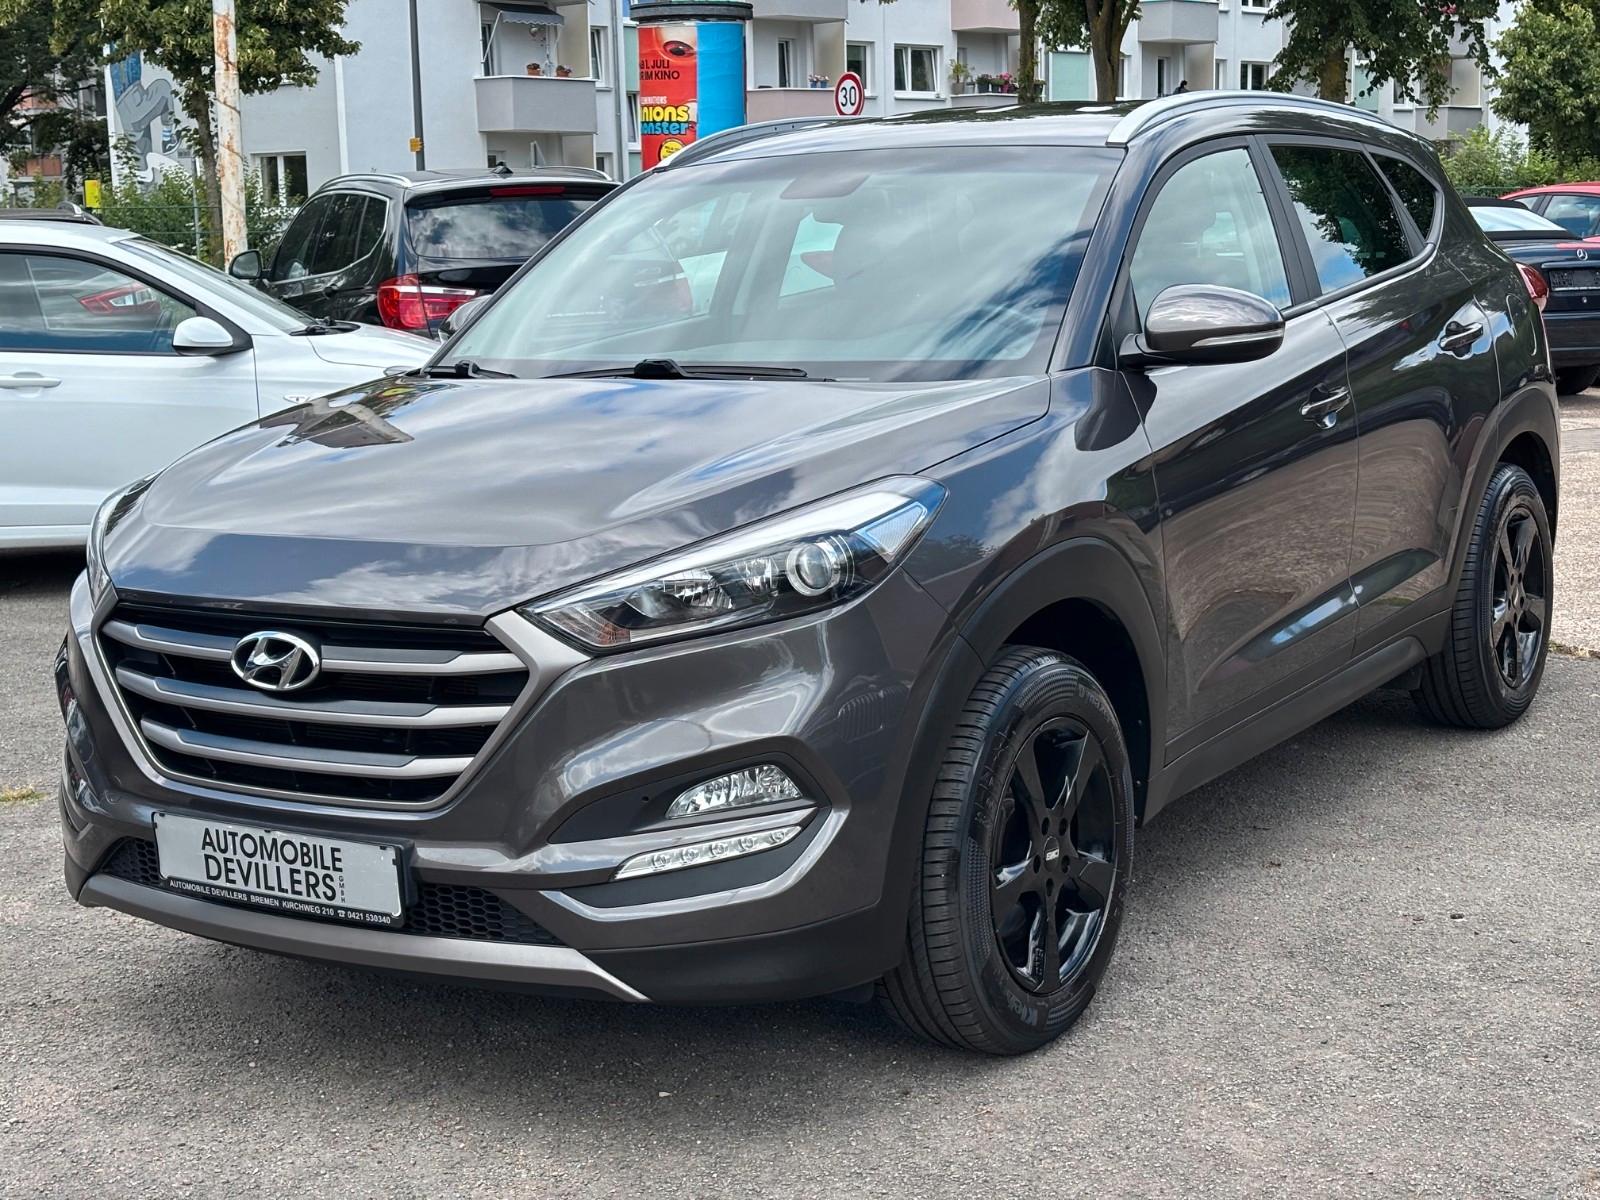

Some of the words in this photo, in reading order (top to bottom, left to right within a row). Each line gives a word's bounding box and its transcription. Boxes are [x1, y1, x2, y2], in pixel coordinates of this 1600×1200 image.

[651, 59, 670, 70] JULI
[654, 71, 680, 81] KINO
[840, 86, 857, 107] 30
[201, 827, 344, 873] AUTOMOBILE
[203, 853, 337, 902] DEVILLERS
[169, 879, 211, 895] AUTOMOBILE
[211, 887, 248, 902] DEVILLERS
[250, 895, 280, 907] BREMEN
[282, 900, 321, 914] KIRCHWEG
[321, 907, 335, 916] 210
[347, 912, 364, 921] 0421
[365, 913, 391, 925] 530340
